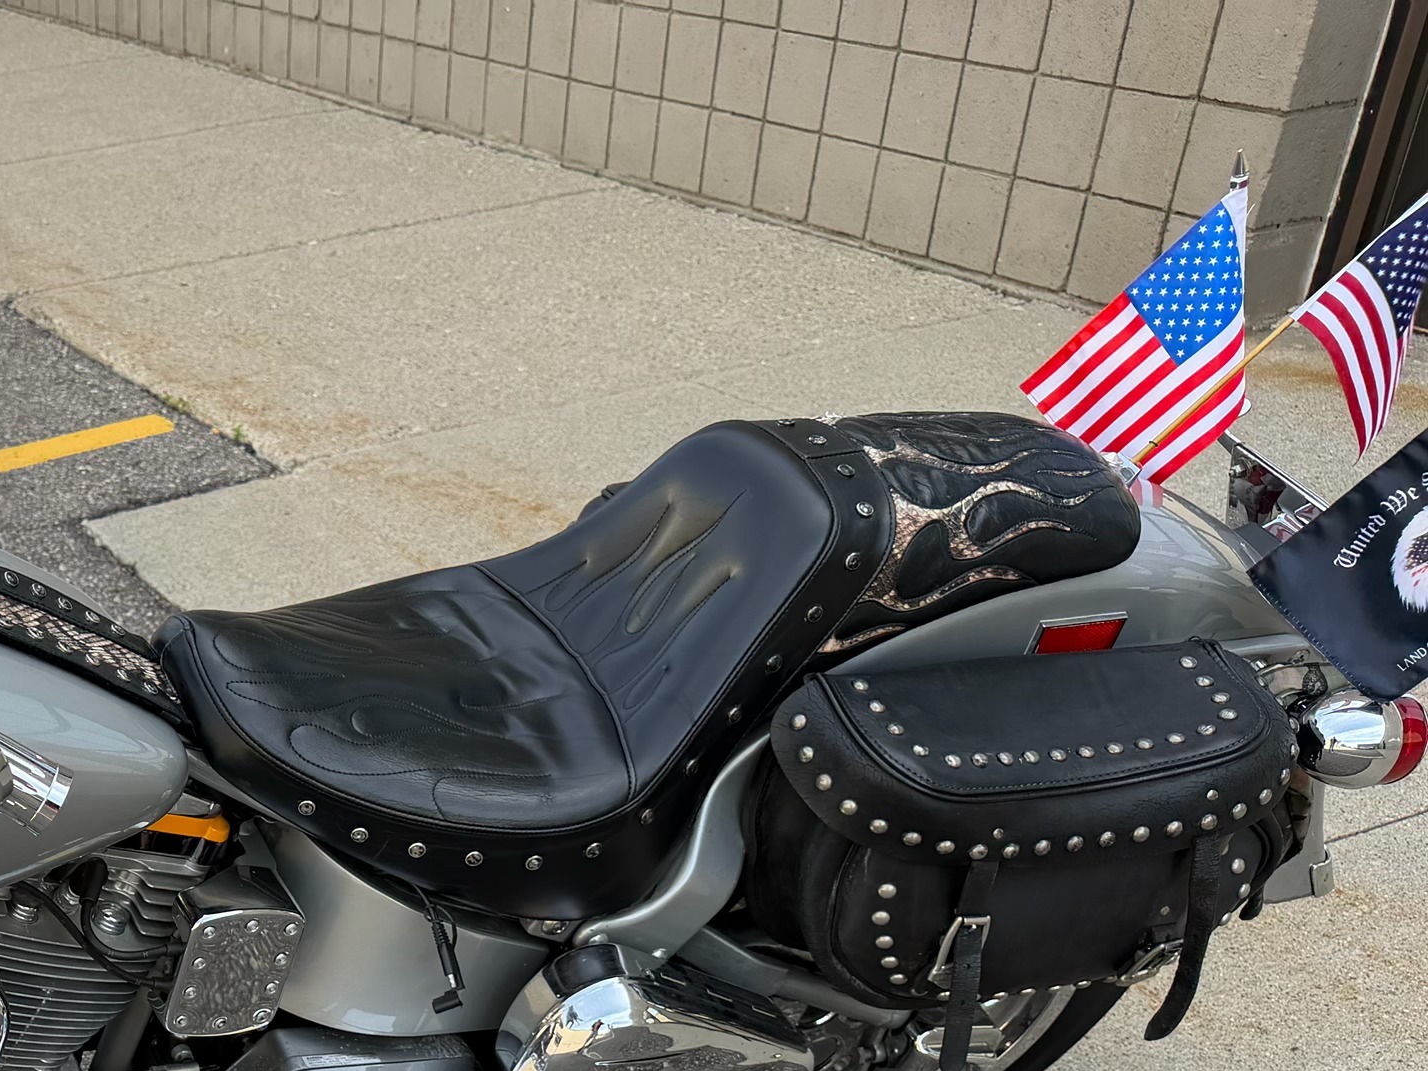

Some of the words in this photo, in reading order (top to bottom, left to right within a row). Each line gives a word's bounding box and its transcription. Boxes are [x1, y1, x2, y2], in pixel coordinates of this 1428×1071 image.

[1333, 514, 1386, 568] United
[1380, 489, 1419, 515] We
[1396, 647, 1427, 672] LAND
